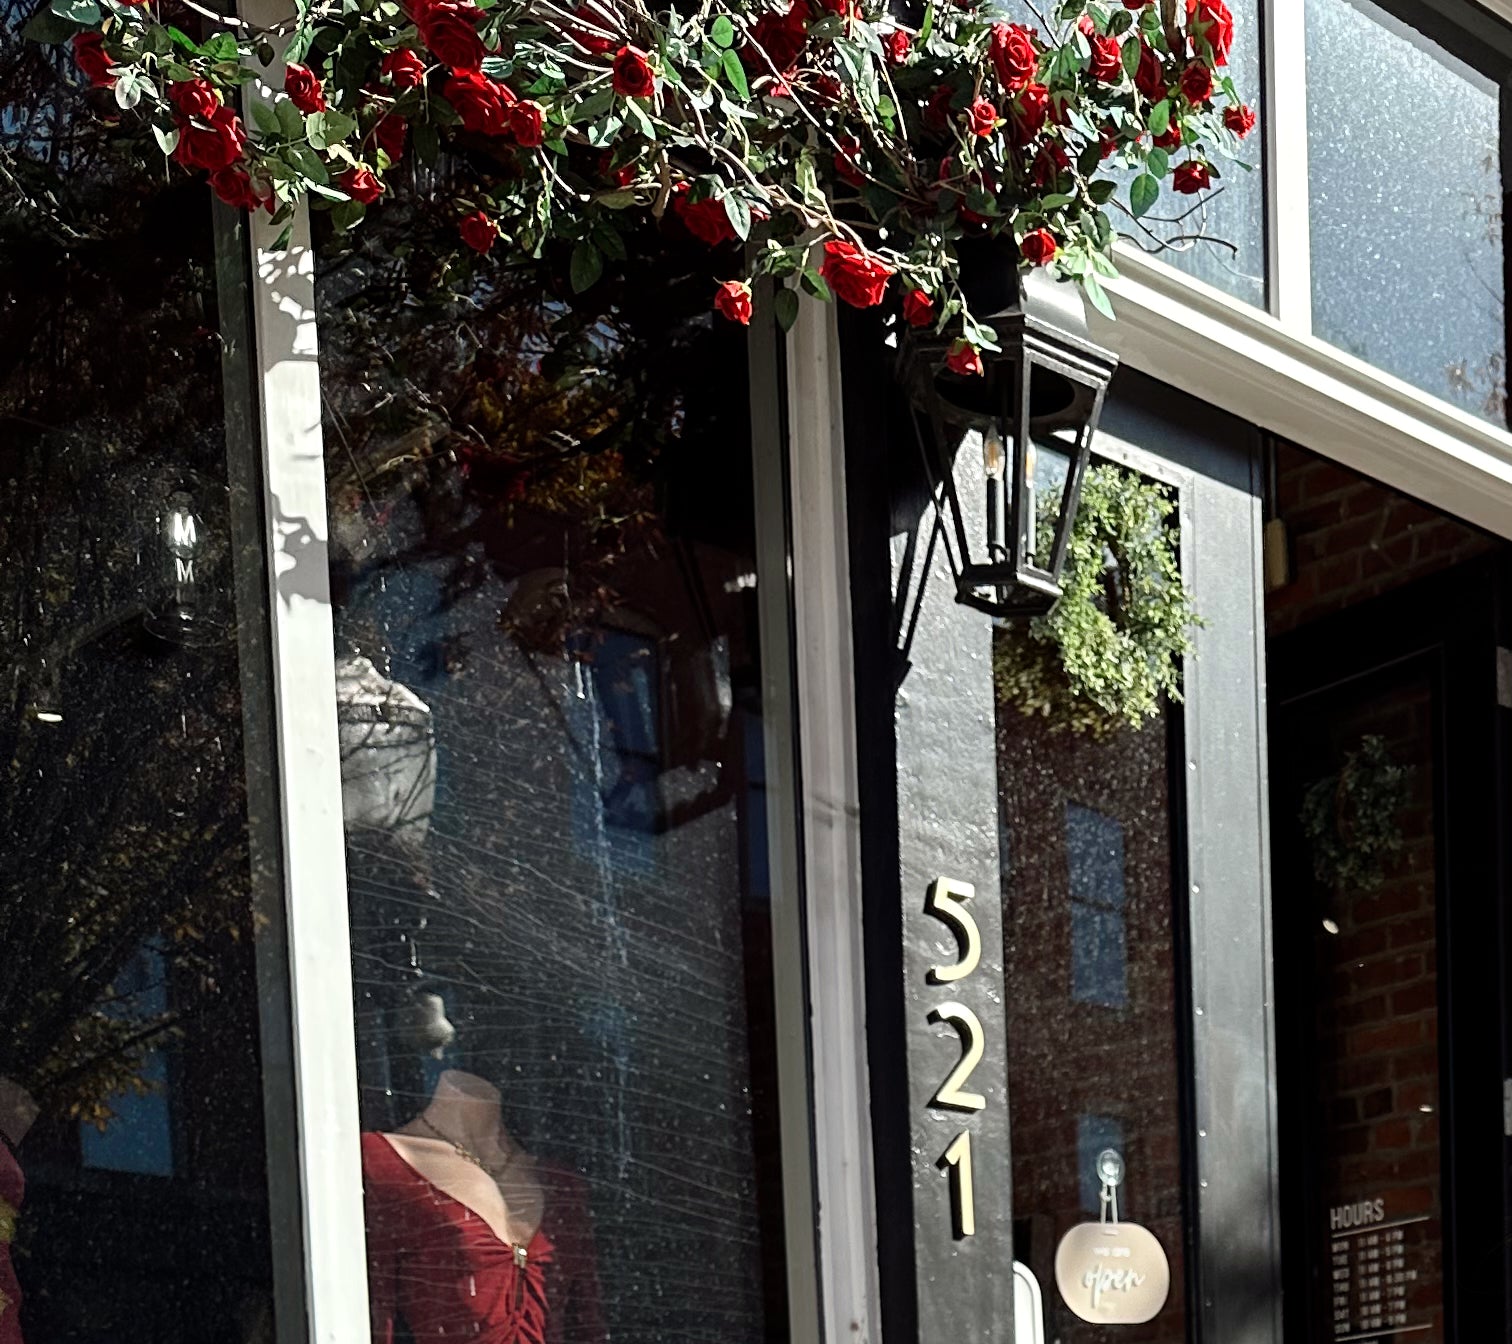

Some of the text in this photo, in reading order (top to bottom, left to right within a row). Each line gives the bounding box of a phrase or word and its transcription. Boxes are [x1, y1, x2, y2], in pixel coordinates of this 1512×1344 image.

[926, 876, 986, 1239] 521
[1330, 1198, 1384, 1230] HOURS
[1082, 1263, 1146, 1309] open
